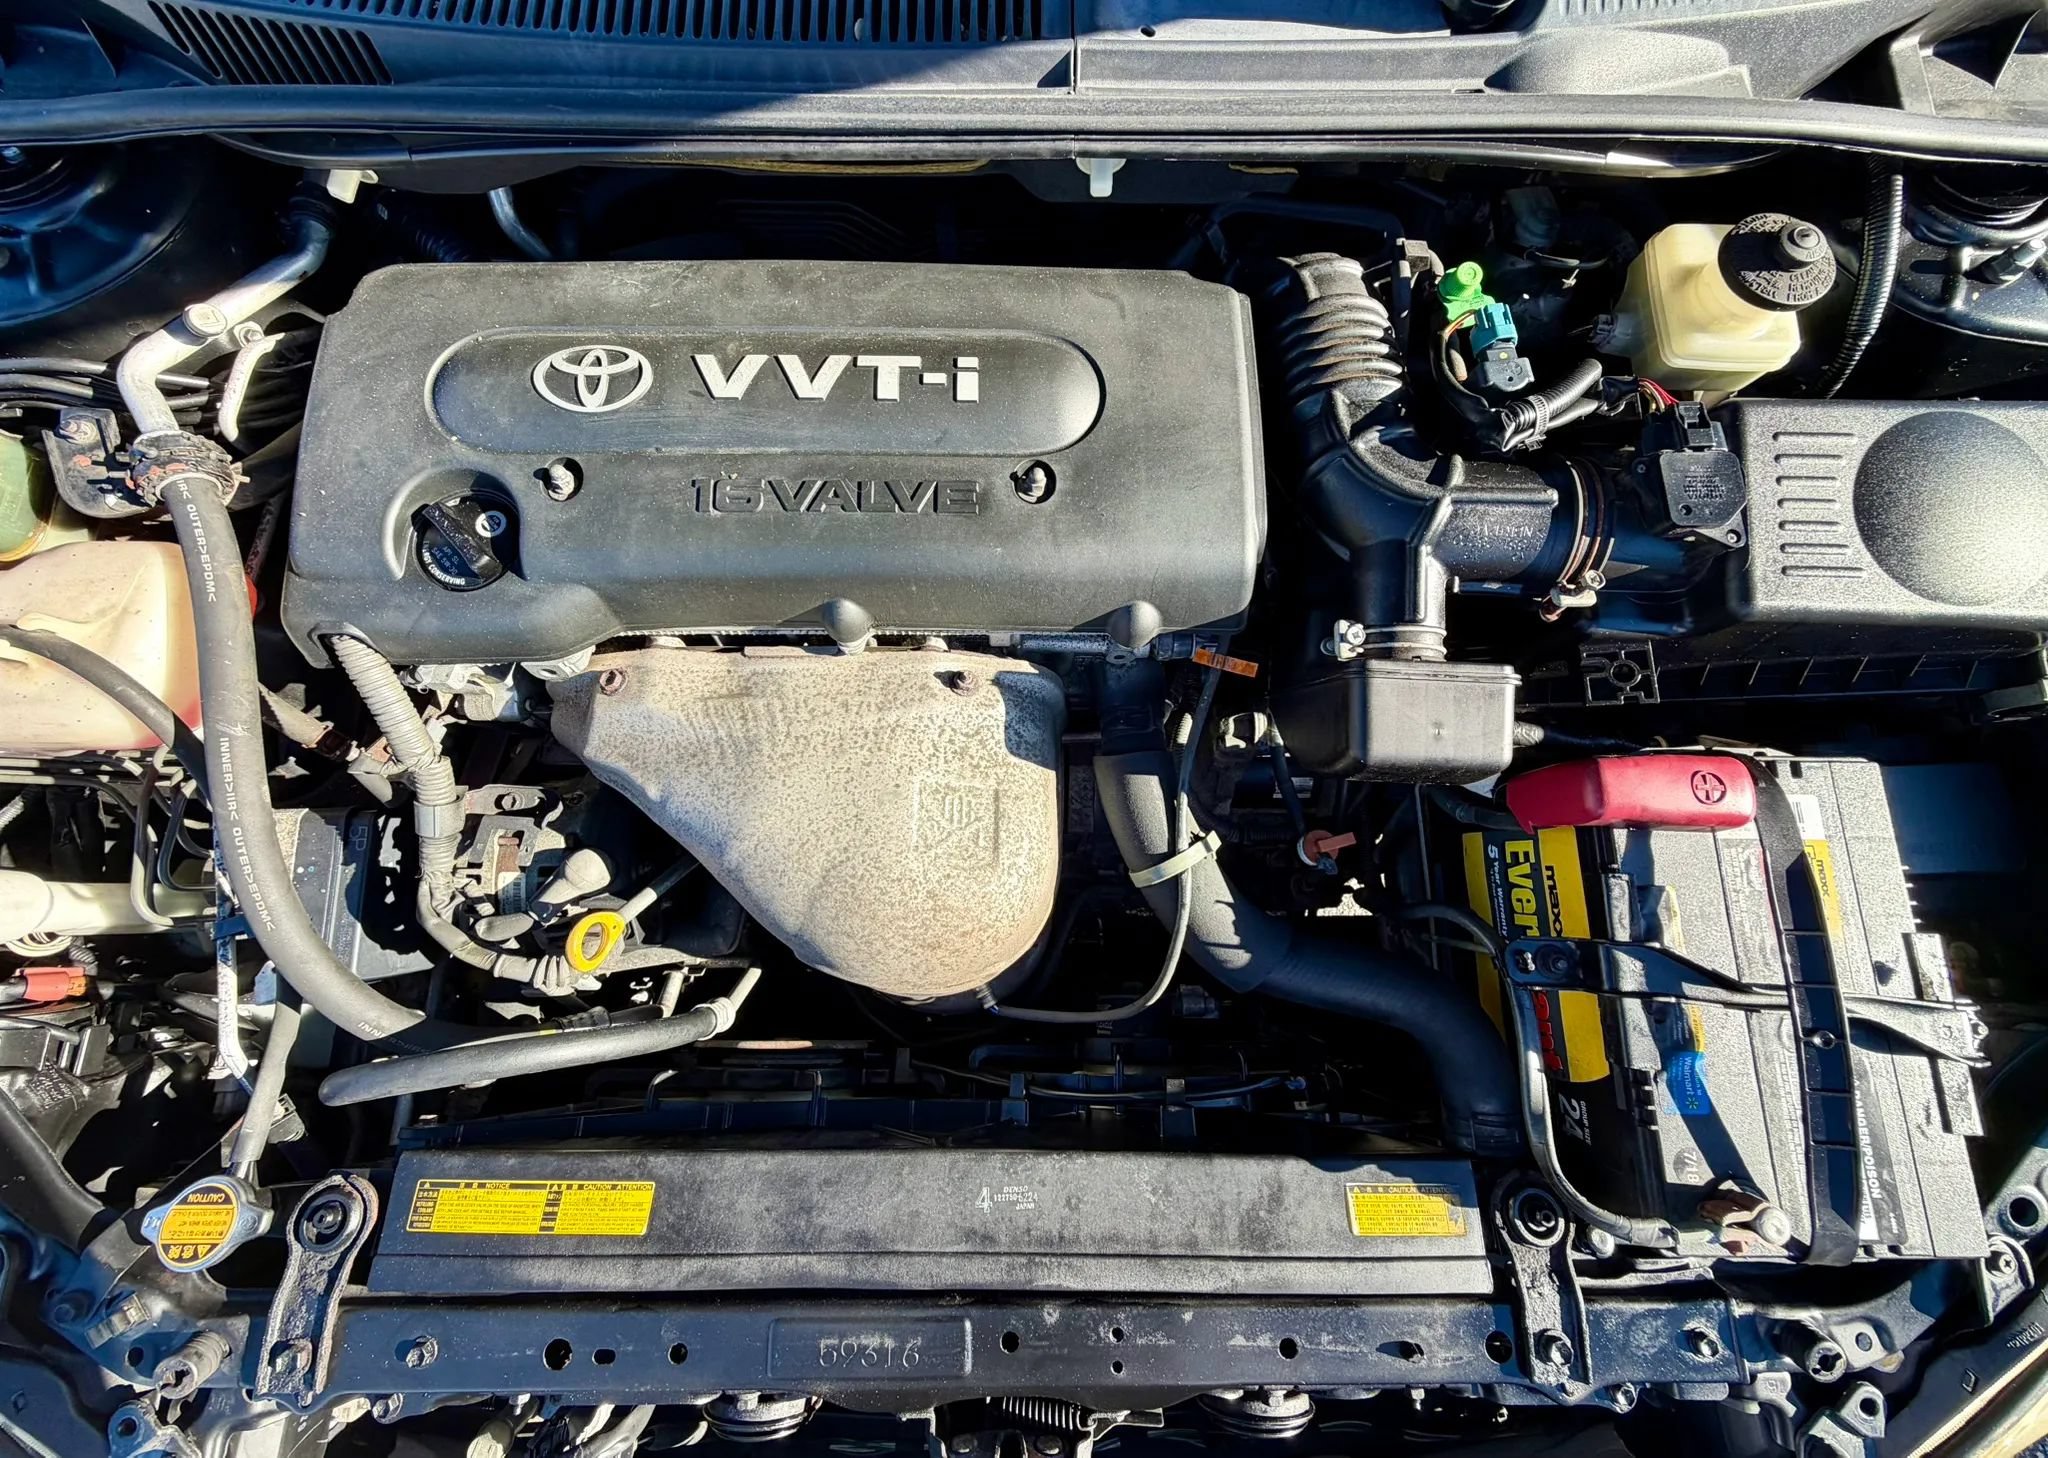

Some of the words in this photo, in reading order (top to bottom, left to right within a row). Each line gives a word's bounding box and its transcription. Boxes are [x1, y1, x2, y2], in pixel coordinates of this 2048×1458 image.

[690, 354, 980, 403] VVT-i
[1487, 844, 1499, 859] 5
[1493, 861, 1501, 886] Year
[1498, 887, 1508, 937] Warranty
[1683, 1056, 1695, 1096] Walmart
[1558, 1092, 1585, 1141] 24
[1683, 1151, 1700, 1183] 7/18
[186, 1193, 226, 1203] CAUTION
[485, 1182, 510, 1190] NOTICE
[1003, 1185, 1028, 1193] DENSO
[1015, 1202, 1035, 1211] JAPAN
[819, 1336, 922, 1368] 59316
